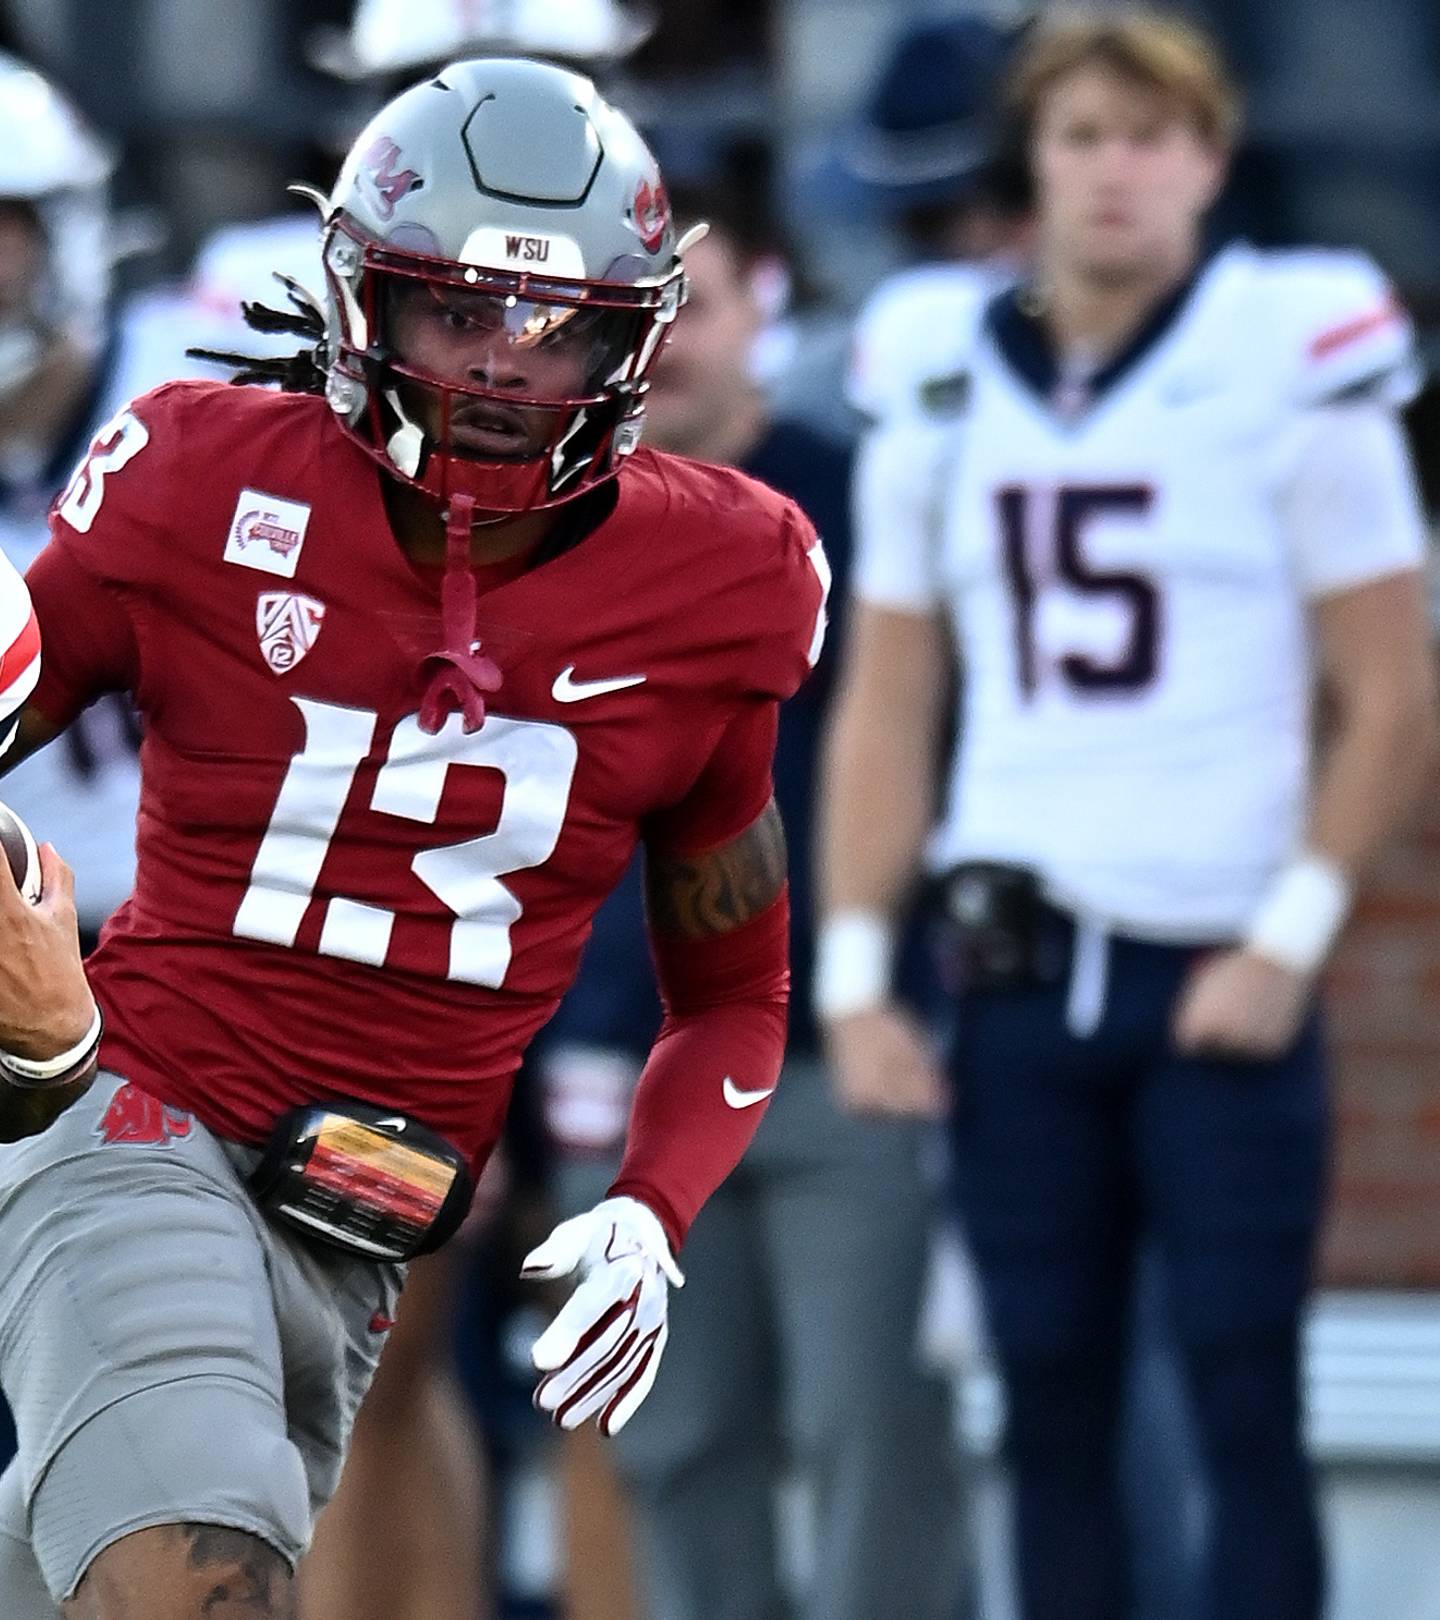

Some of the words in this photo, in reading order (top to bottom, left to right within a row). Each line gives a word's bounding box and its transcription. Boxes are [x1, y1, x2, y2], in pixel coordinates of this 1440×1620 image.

[505, 235, 550, 262] WSU
[993, 483, 1162, 706] 15
[233, 696, 578, 990] 13
